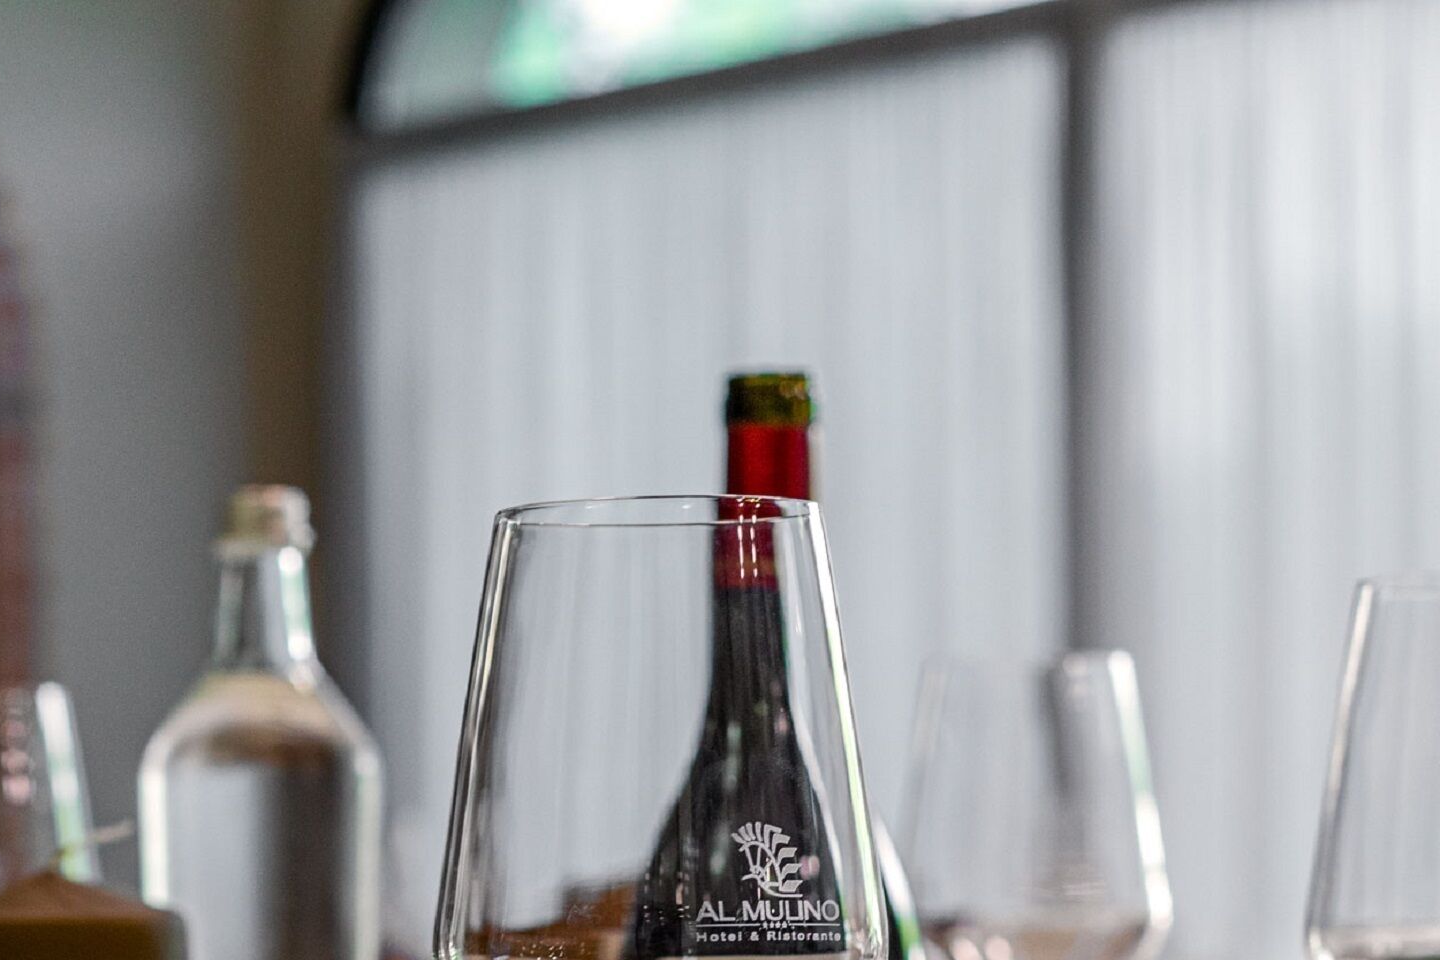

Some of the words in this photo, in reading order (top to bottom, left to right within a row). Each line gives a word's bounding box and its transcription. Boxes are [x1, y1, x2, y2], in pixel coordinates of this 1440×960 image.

[696, 899, 736, 922] AL
[742, 899, 840, 923] MULINO
[695, 931, 743, 942] Hotel
[749, 931, 760, 942] &
[766, 931, 841, 943] Ristorante
